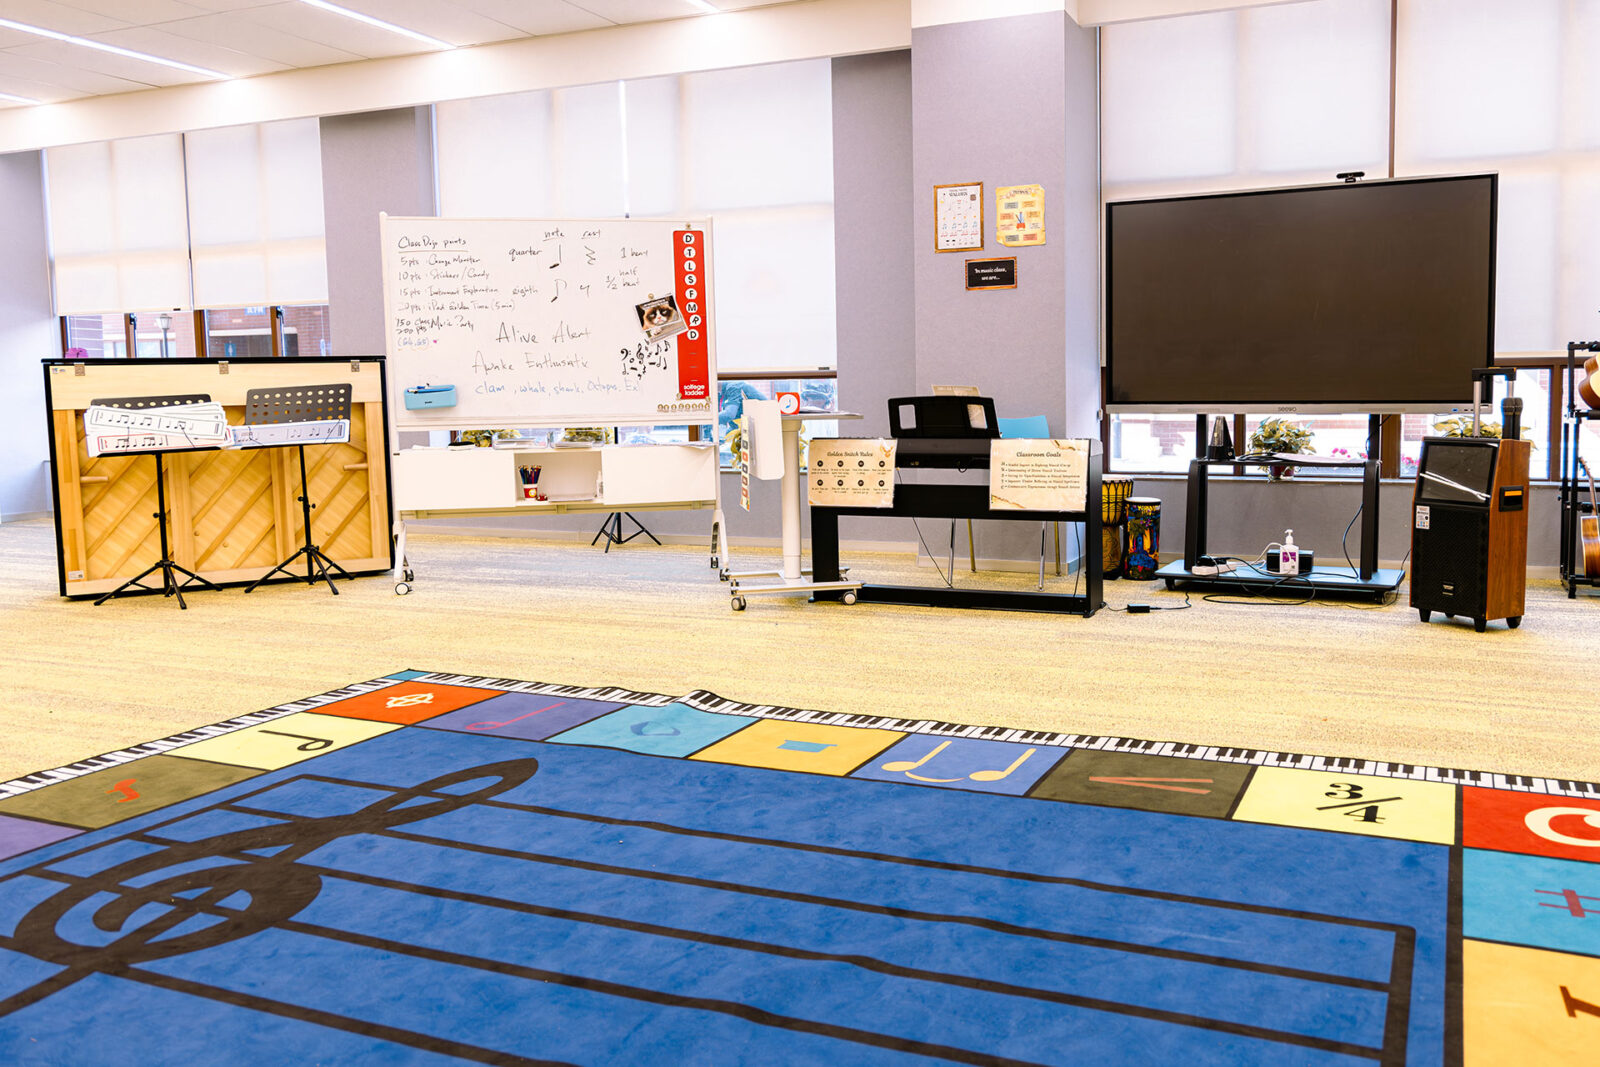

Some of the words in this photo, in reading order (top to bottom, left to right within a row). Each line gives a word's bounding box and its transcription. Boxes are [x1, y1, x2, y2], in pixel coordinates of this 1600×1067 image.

[544, 228, 564, 238] note
[582, 229, 601, 238] rest
[508, 246, 542, 261] quarter
[630, 248, 648, 257] beat
[512, 285, 538, 297] eighth
[496, 321, 539, 343] Alive
[552, 320, 592, 343] Alert
[472, 350, 515, 375] Awake
